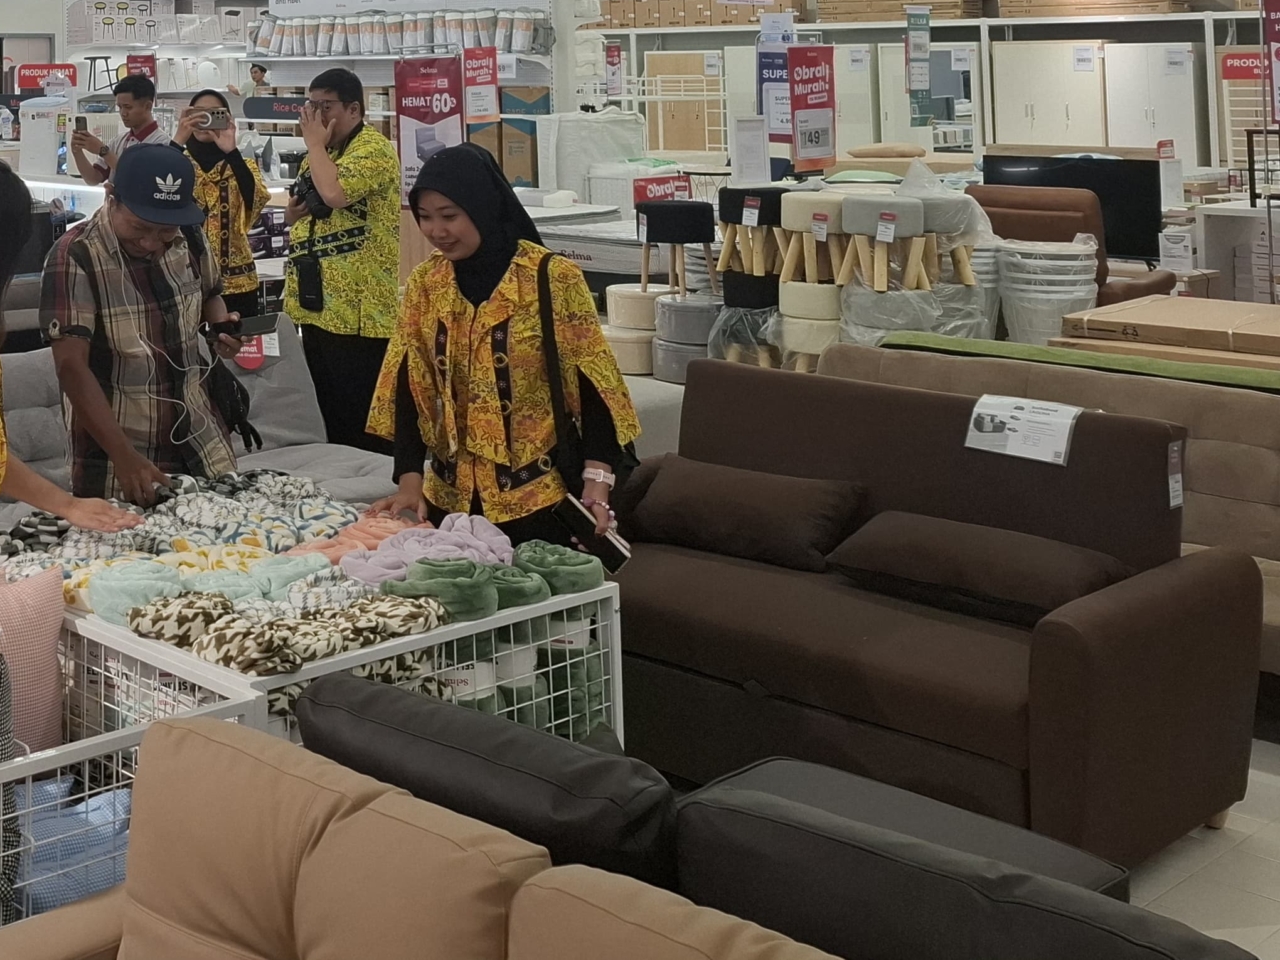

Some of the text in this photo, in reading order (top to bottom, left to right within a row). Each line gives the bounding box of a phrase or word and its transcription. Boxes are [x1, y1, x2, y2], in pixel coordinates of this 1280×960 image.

[20, 68, 48, 76] PRODUK
[762, 69, 788, 79] SUPE
[793, 61, 825, 81] Obral
[401, 96, 432, 107] HEMAT
[272, 102, 290, 112] Rice
[153, 192, 181, 201] adidas
[560, 248, 593, 261] Selma
